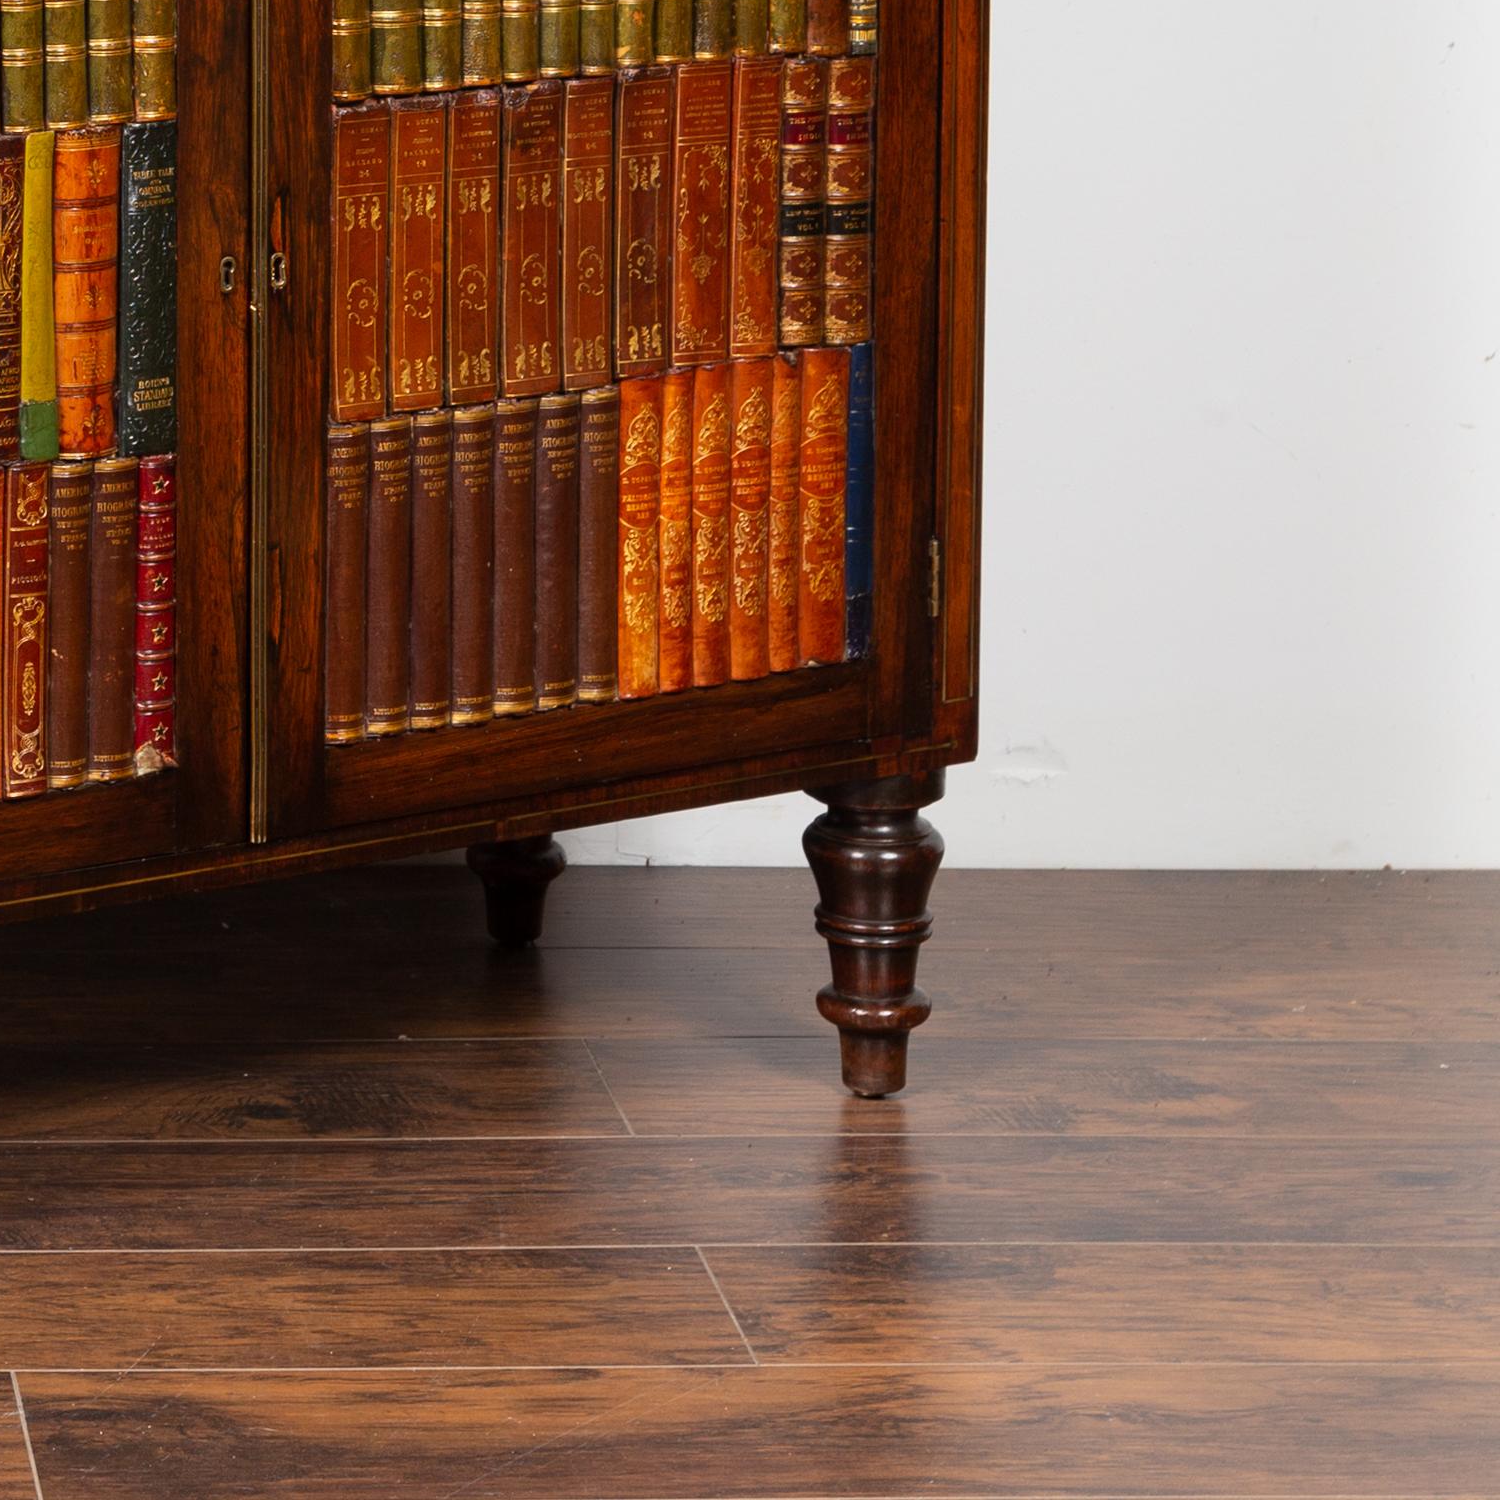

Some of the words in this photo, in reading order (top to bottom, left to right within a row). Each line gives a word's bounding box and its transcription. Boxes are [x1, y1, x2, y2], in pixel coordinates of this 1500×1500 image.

[1, 368, 20, 376] AFRIC
[133, 387, 174, 402] STANDARD
[136, 399, 172, 412] LIBRARY
